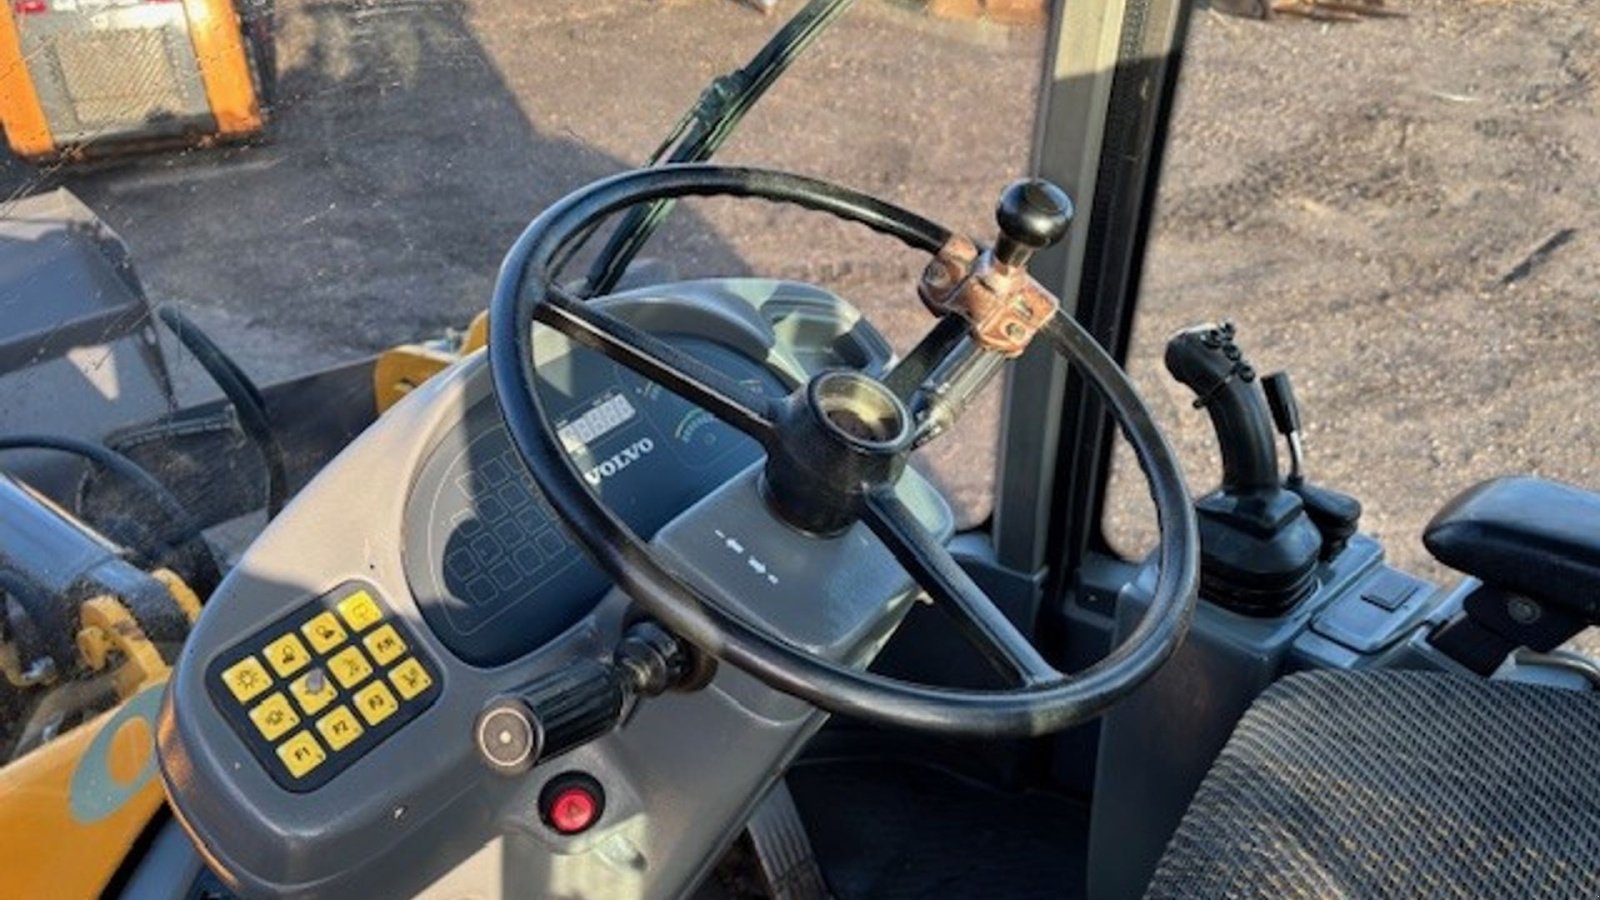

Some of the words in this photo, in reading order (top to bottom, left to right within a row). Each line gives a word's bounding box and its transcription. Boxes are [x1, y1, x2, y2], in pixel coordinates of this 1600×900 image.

[583, 437, 654, 486] VOLVO
[332, 720, 349, 735] F2
[294, 746, 312, 761] F1
